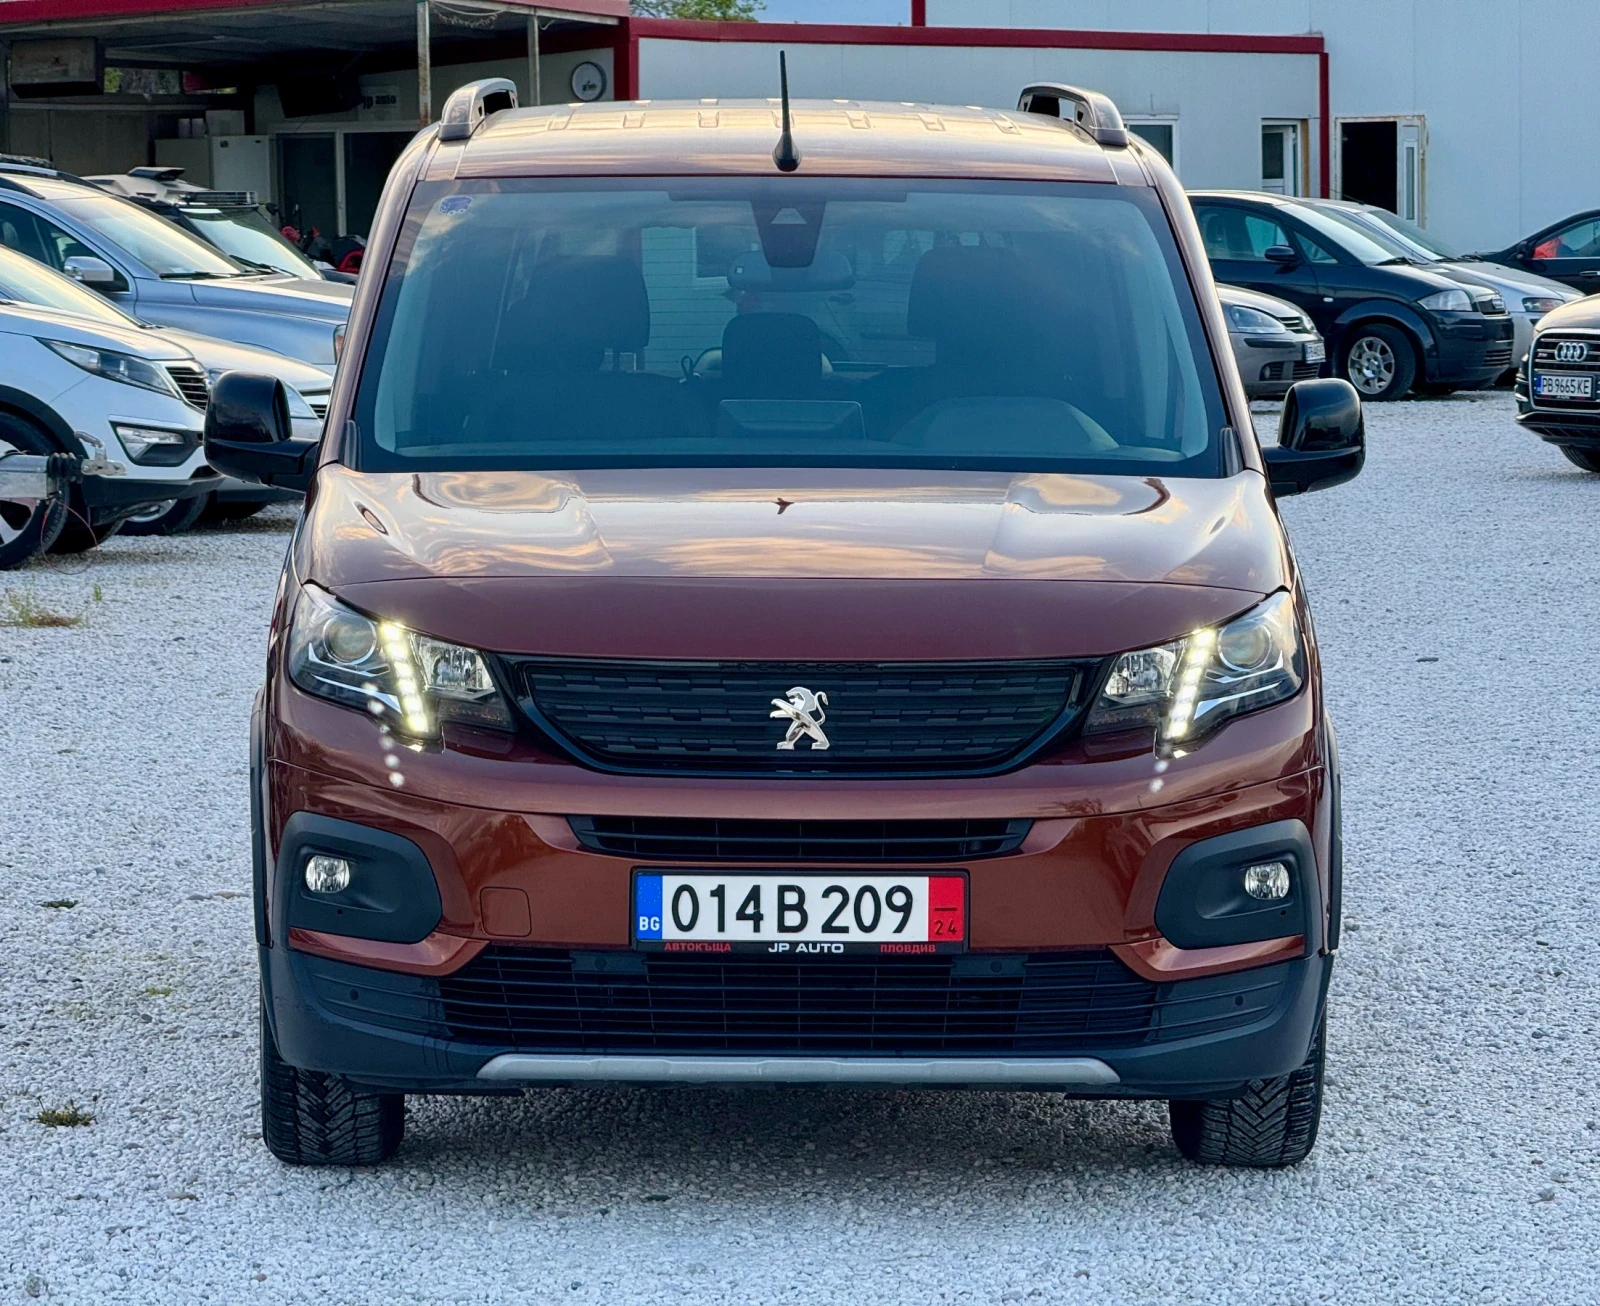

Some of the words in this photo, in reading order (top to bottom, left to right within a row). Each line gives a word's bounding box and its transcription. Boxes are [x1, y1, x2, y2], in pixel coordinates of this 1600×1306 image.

[639, 916, 660, 931] BG
[934, 920, 957, 935] 24
[664, 942, 732, 952] АВТОКЪЩА
[768, 943, 791, 953] JP
[795, 943, 844, 953] AUTO
[880, 944, 936, 953] ПЛОВДИВ
